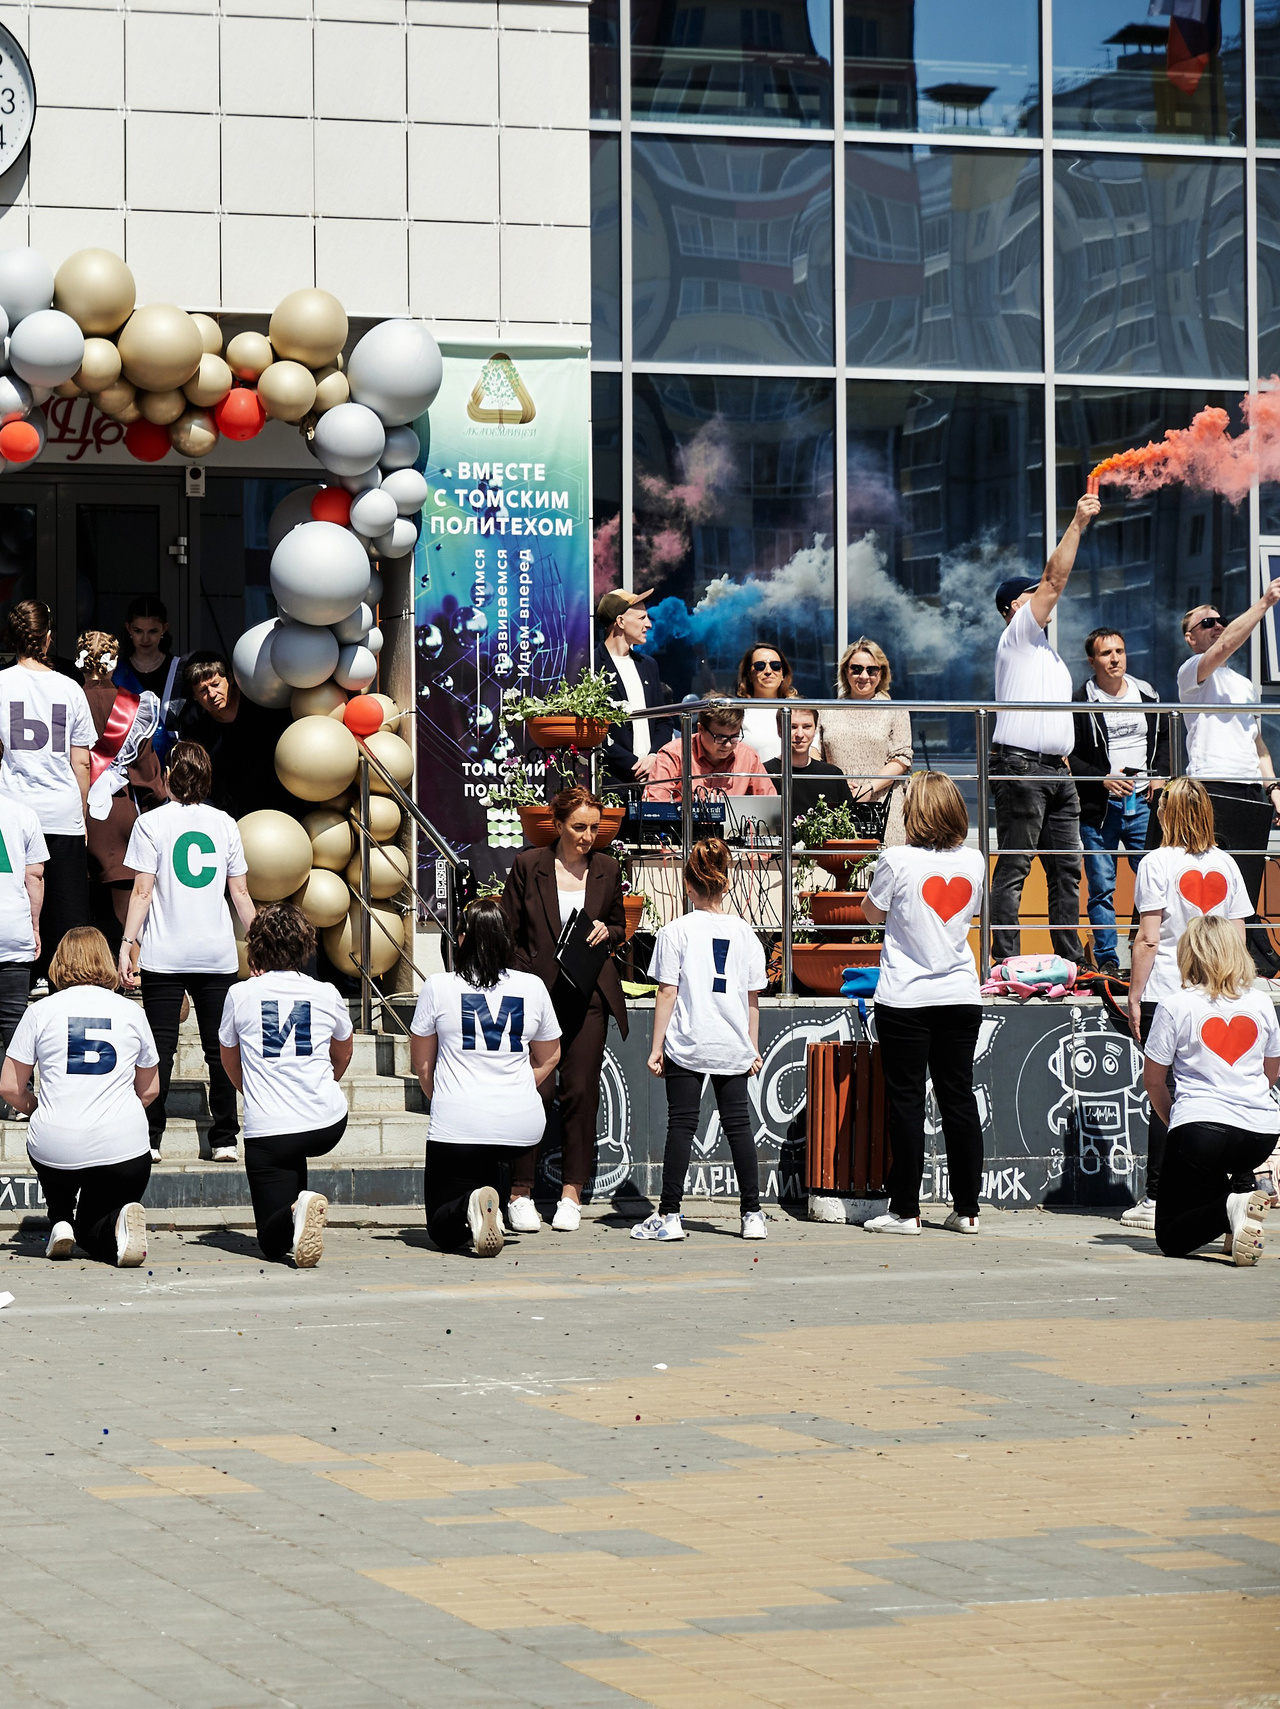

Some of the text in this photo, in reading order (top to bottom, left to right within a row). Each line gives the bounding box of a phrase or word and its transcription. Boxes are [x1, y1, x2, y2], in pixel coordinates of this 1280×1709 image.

[0, 88, 15, 115] 3
[433, 488, 569, 509] С ТОМСКИМ
[458, 461, 546, 482] ВМЕСТЕ
[430, 515, 573, 537] ПОЛИТЕХОМ
[472, 549, 486, 620] Учимся
[495, 549, 508, 675] Развиваемся
[517, 549, 533, 677] Идем вперед
[9, 701, 67, 753] Ы
[462, 759, 546, 777] ТОМСИЙ
[173, 831, 217, 889] С
[712, 938, 730, 993] !
[66, 1016, 117, 1075] Б
[261, 1000, 312, 1058] И
[461, 993, 524, 1052] М
